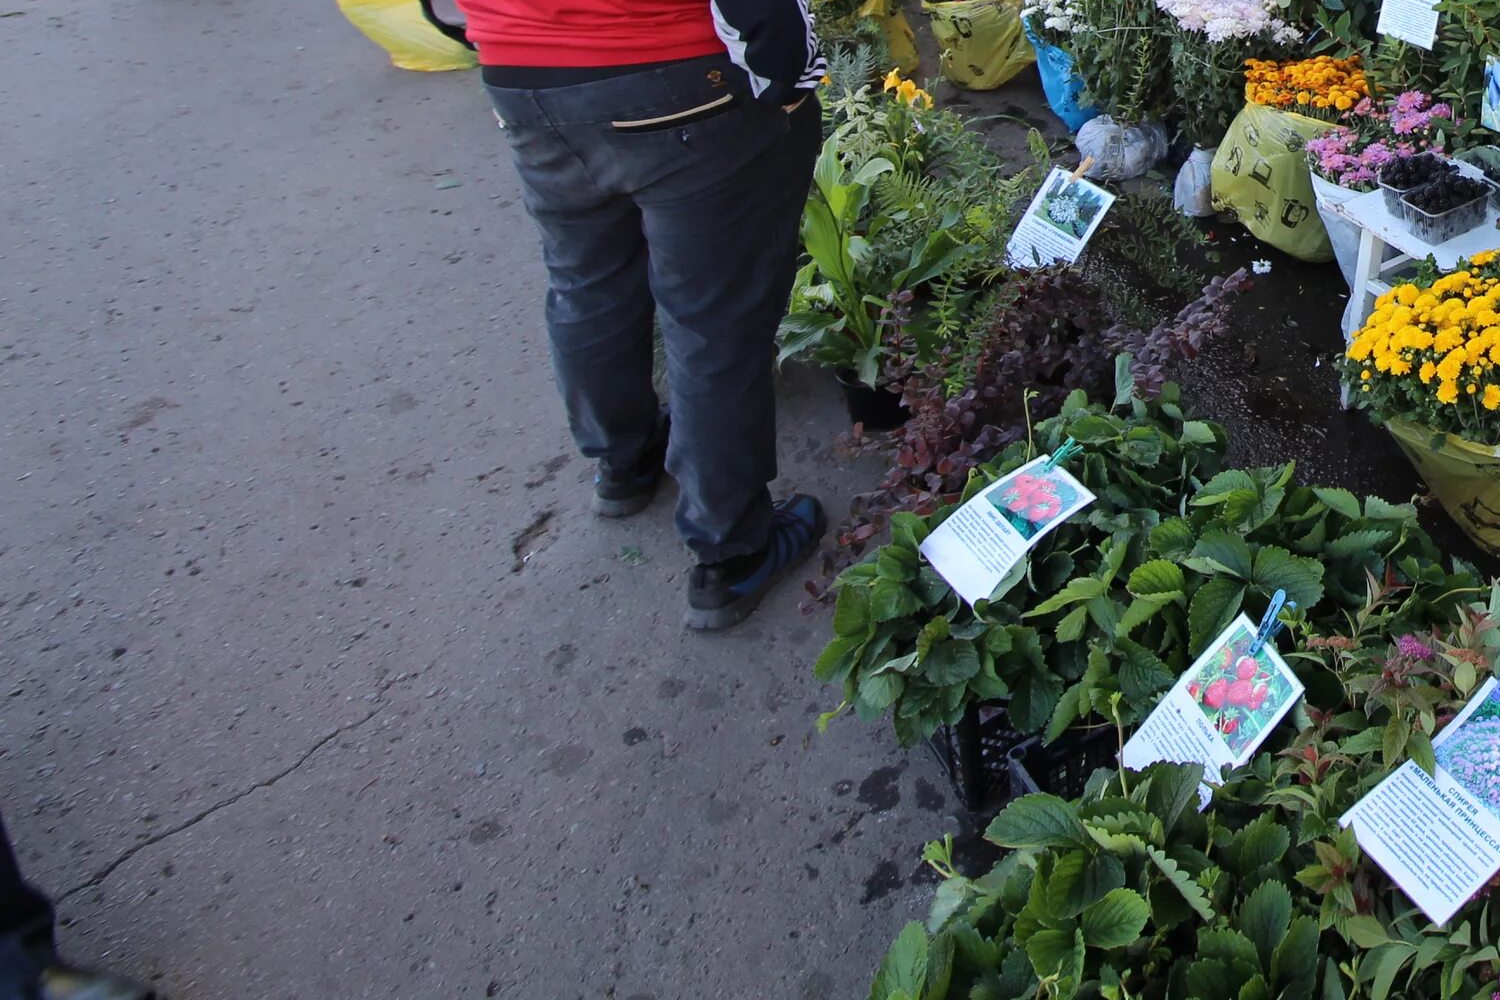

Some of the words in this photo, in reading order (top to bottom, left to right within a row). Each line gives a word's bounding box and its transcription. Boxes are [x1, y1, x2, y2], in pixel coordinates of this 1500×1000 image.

[1197, 718, 1214, 744] ПОЛЬКА
[1408, 764, 1457, 809] «МАЛЕНЬКАЯ
[1448, 787, 1479, 816] СПИРЕЯ
